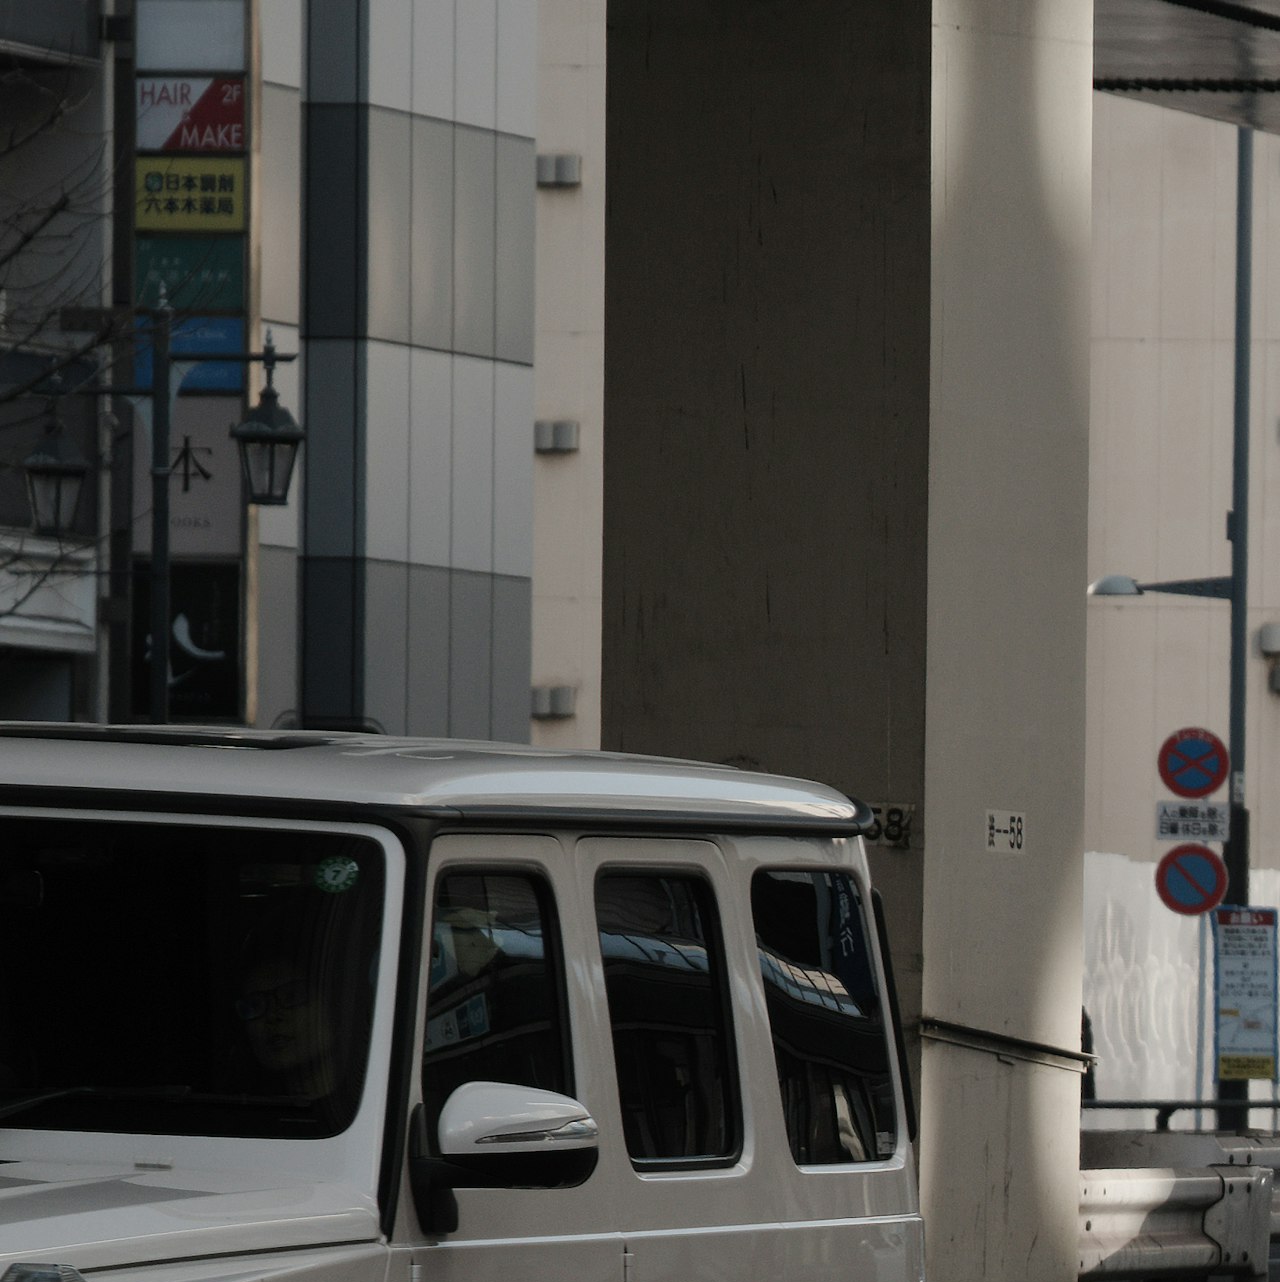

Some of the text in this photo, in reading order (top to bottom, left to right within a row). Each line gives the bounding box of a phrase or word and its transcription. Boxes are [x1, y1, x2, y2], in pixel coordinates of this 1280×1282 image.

[140, 83, 191, 105] HAIR
[221, 84, 241, 103] 2F
[180, 123, 242, 147] MAKE
[166, 174, 234, 192] 日本調剤
[145, 197, 234, 215] 六本木薬局
[171, 516, 211, 528] OOKS
[332, 869, 341, 881] 7
